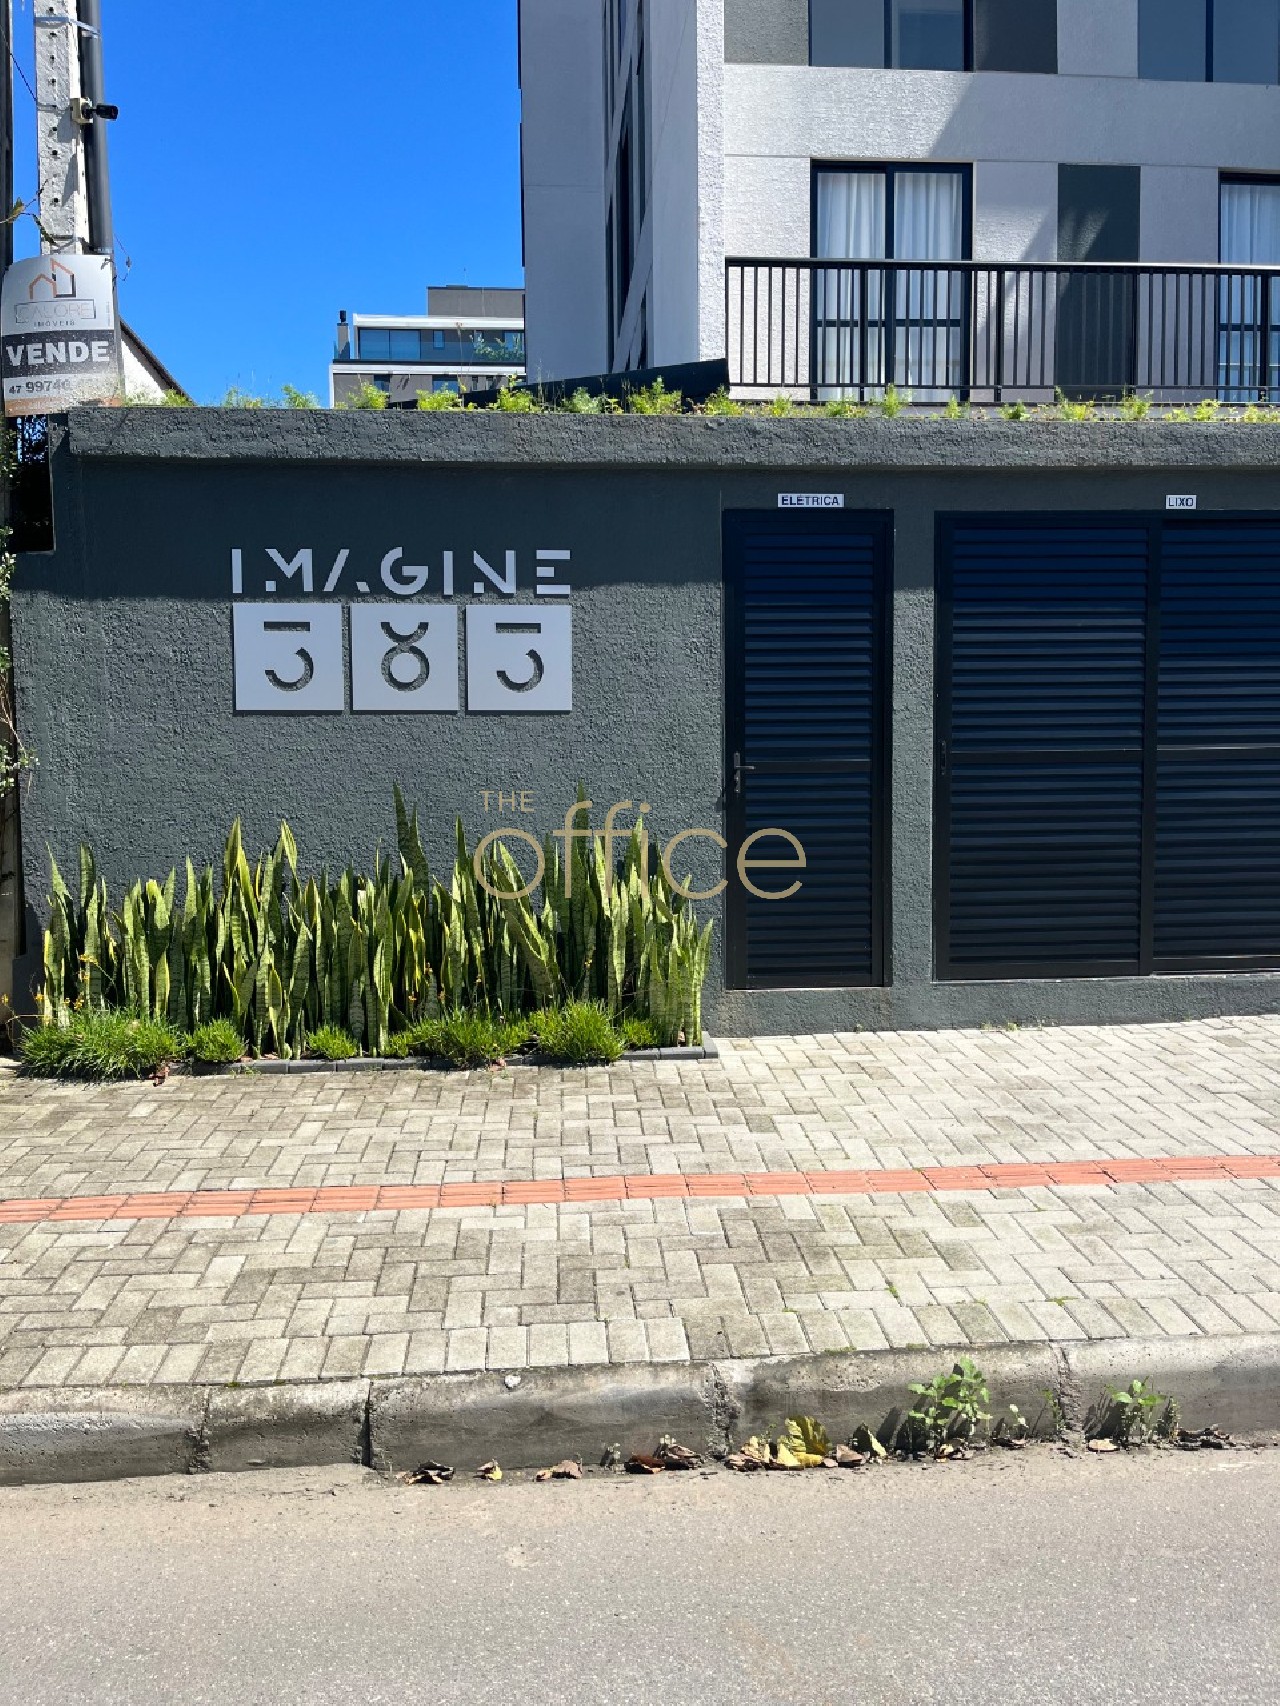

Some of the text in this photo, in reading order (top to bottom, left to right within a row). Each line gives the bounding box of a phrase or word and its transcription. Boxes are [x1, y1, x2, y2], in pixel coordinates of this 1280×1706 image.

[6, 341, 110, 366] VENDE
[8, 385, 22, 394] 47
[1168, 497, 1194, 507] LIXO
[231, 547, 571, 595] IMAGINE
[263, 621, 545, 693] 585
